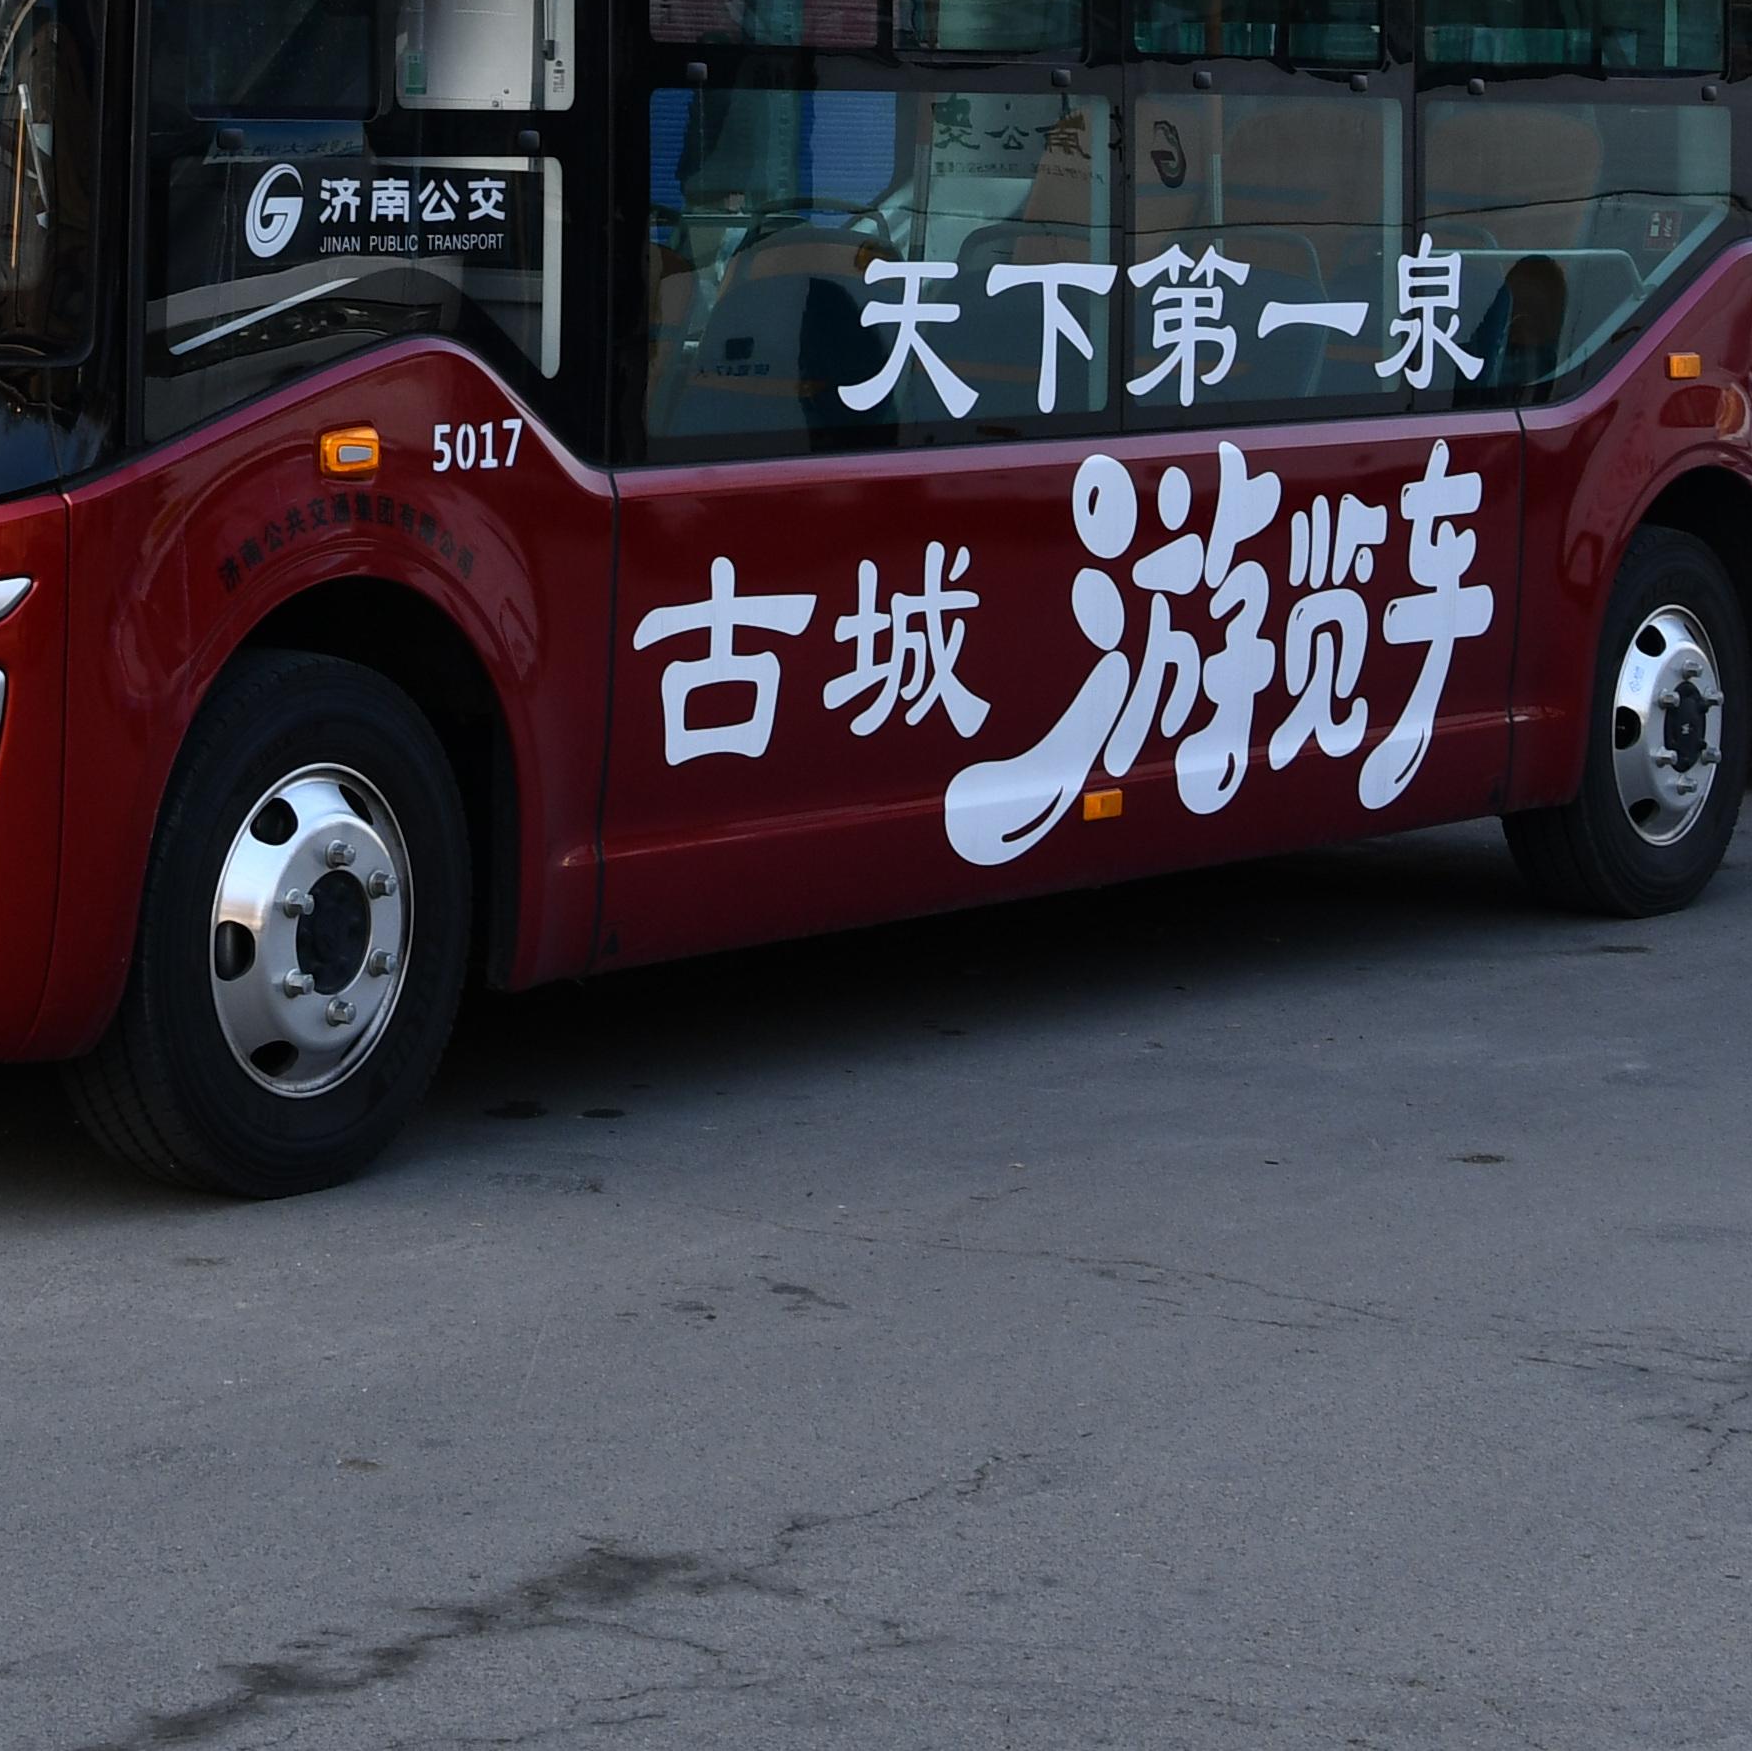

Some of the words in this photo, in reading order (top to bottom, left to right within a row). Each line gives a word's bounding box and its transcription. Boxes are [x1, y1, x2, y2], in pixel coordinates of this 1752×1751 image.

[319, 177, 507, 224] 济南公交
[320, 235, 360, 253] JINAN
[369, 234, 418, 252] PUBLIC
[427, 233, 504, 251] TRANSPORT
[838, 232, 1484, 418] 天下第一泉
[432, 418, 523, 473] 5017
[633, 540, 991, 767] 古城
[944, 438, 1493, 865] 游览车
